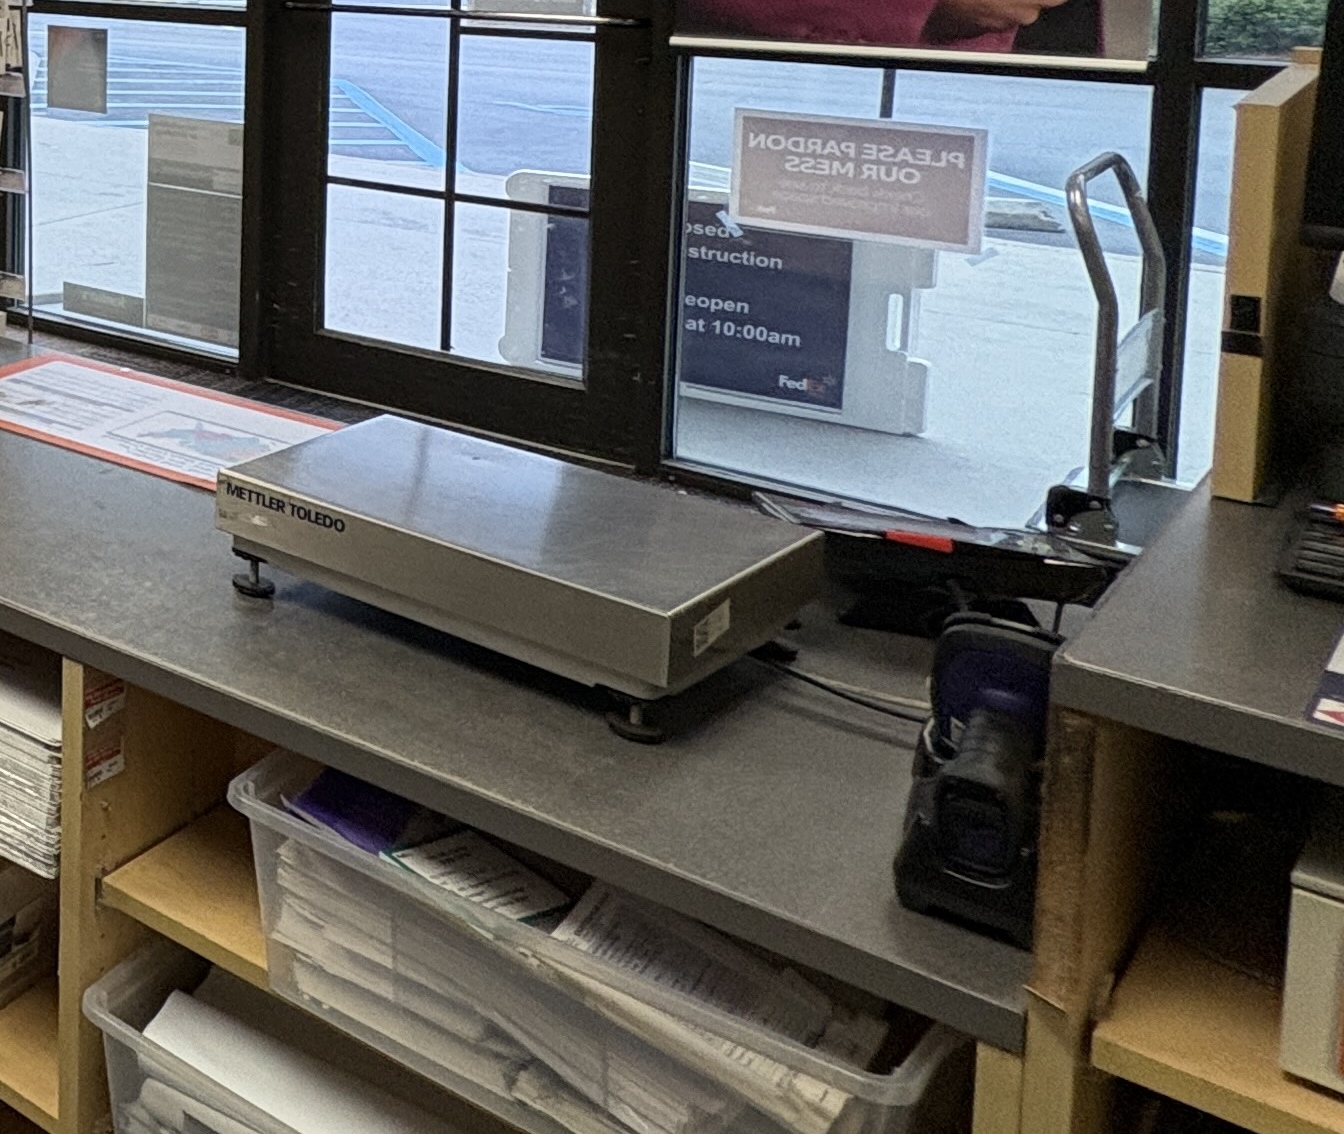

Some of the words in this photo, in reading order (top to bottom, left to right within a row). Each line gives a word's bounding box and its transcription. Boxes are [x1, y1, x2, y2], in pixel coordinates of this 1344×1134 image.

[685, 294, 750, 315] eopen
[685, 318, 706, 333] at
[711, 319, 802, 348] 10:00am
[226, 482, 286, 514] METTLER
[289, 502, 346, 533] TOLEDO
